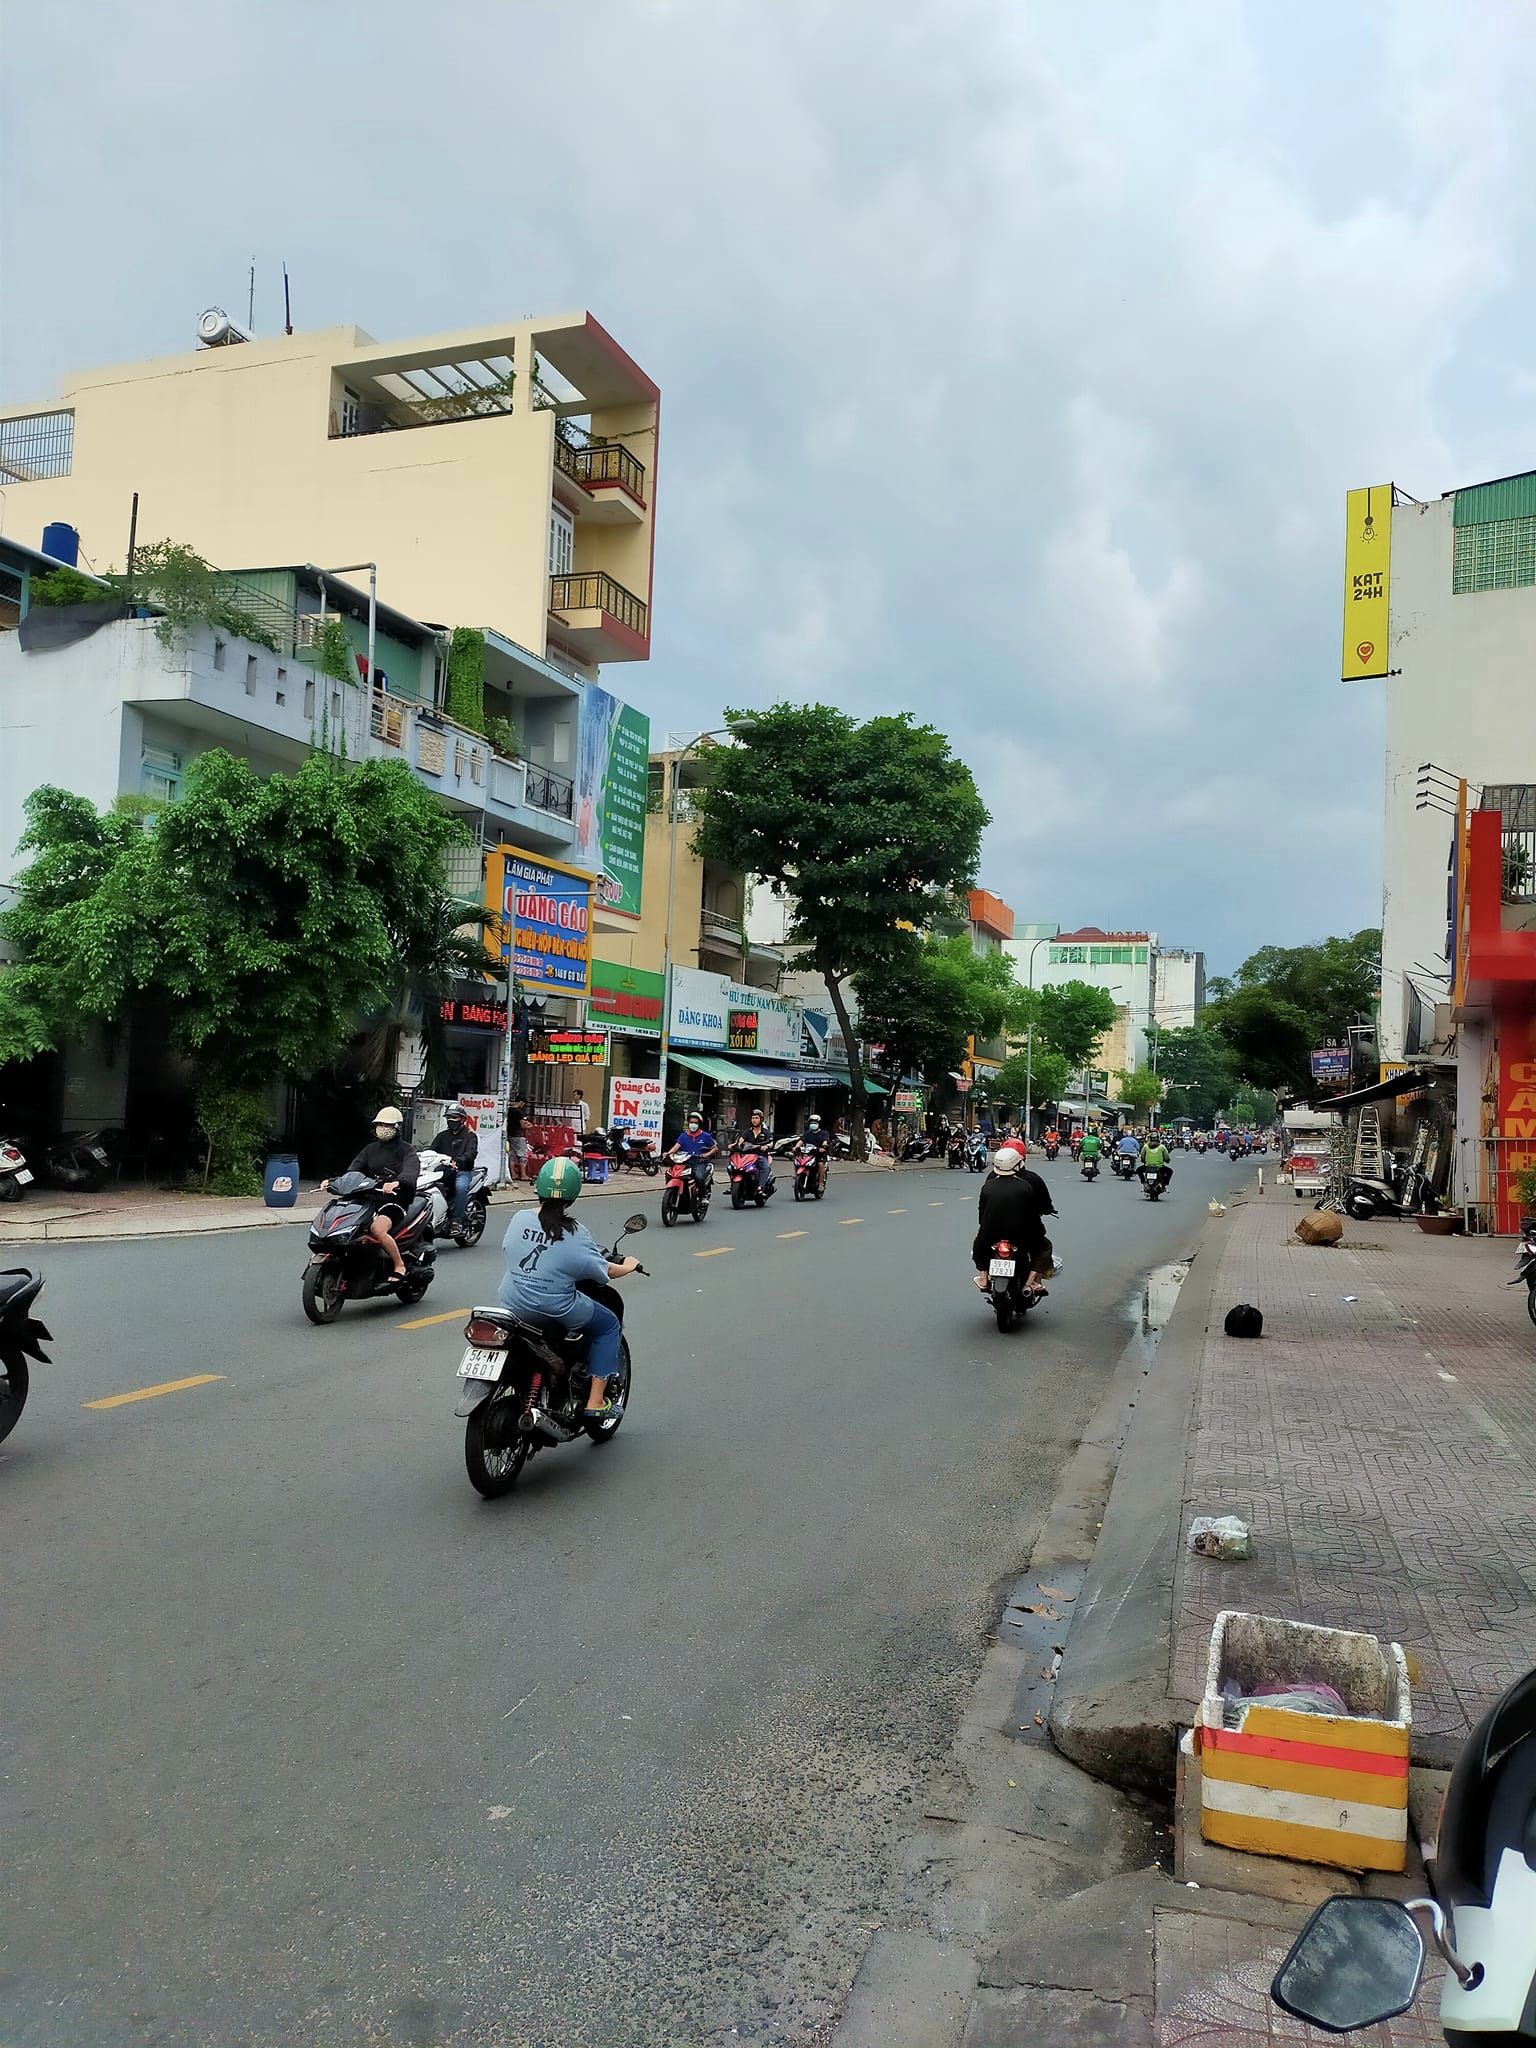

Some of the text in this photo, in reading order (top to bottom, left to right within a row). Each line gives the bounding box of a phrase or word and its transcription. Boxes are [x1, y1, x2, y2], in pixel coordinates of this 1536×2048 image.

[1353, 572, 1383, 587] KAT
[1353, 586, 1383, 601] 24H
[506, 860, 554, 886] LÂM GIA PHÁT
[558, 899, 588, 932] CÁO
[702, 1013, 723, 1029] KHOA
[556, 1053, 574, 1062] LED
[574, 1053, 591, 1063] GIÁ
[615, 1080, 661, 1095] Quảng Cáo
[460, 1096, 495, 1111] Quảng Cáo
[613, 1117, 659, 1130] DECAL BẠT
[636, 1128, 653, 1138] CÔNG
[522, 1228, 555, 1246] STA
[470, 1349, 500, 1363] 54-N1
[463, 1362, 495, 1377] 9601
